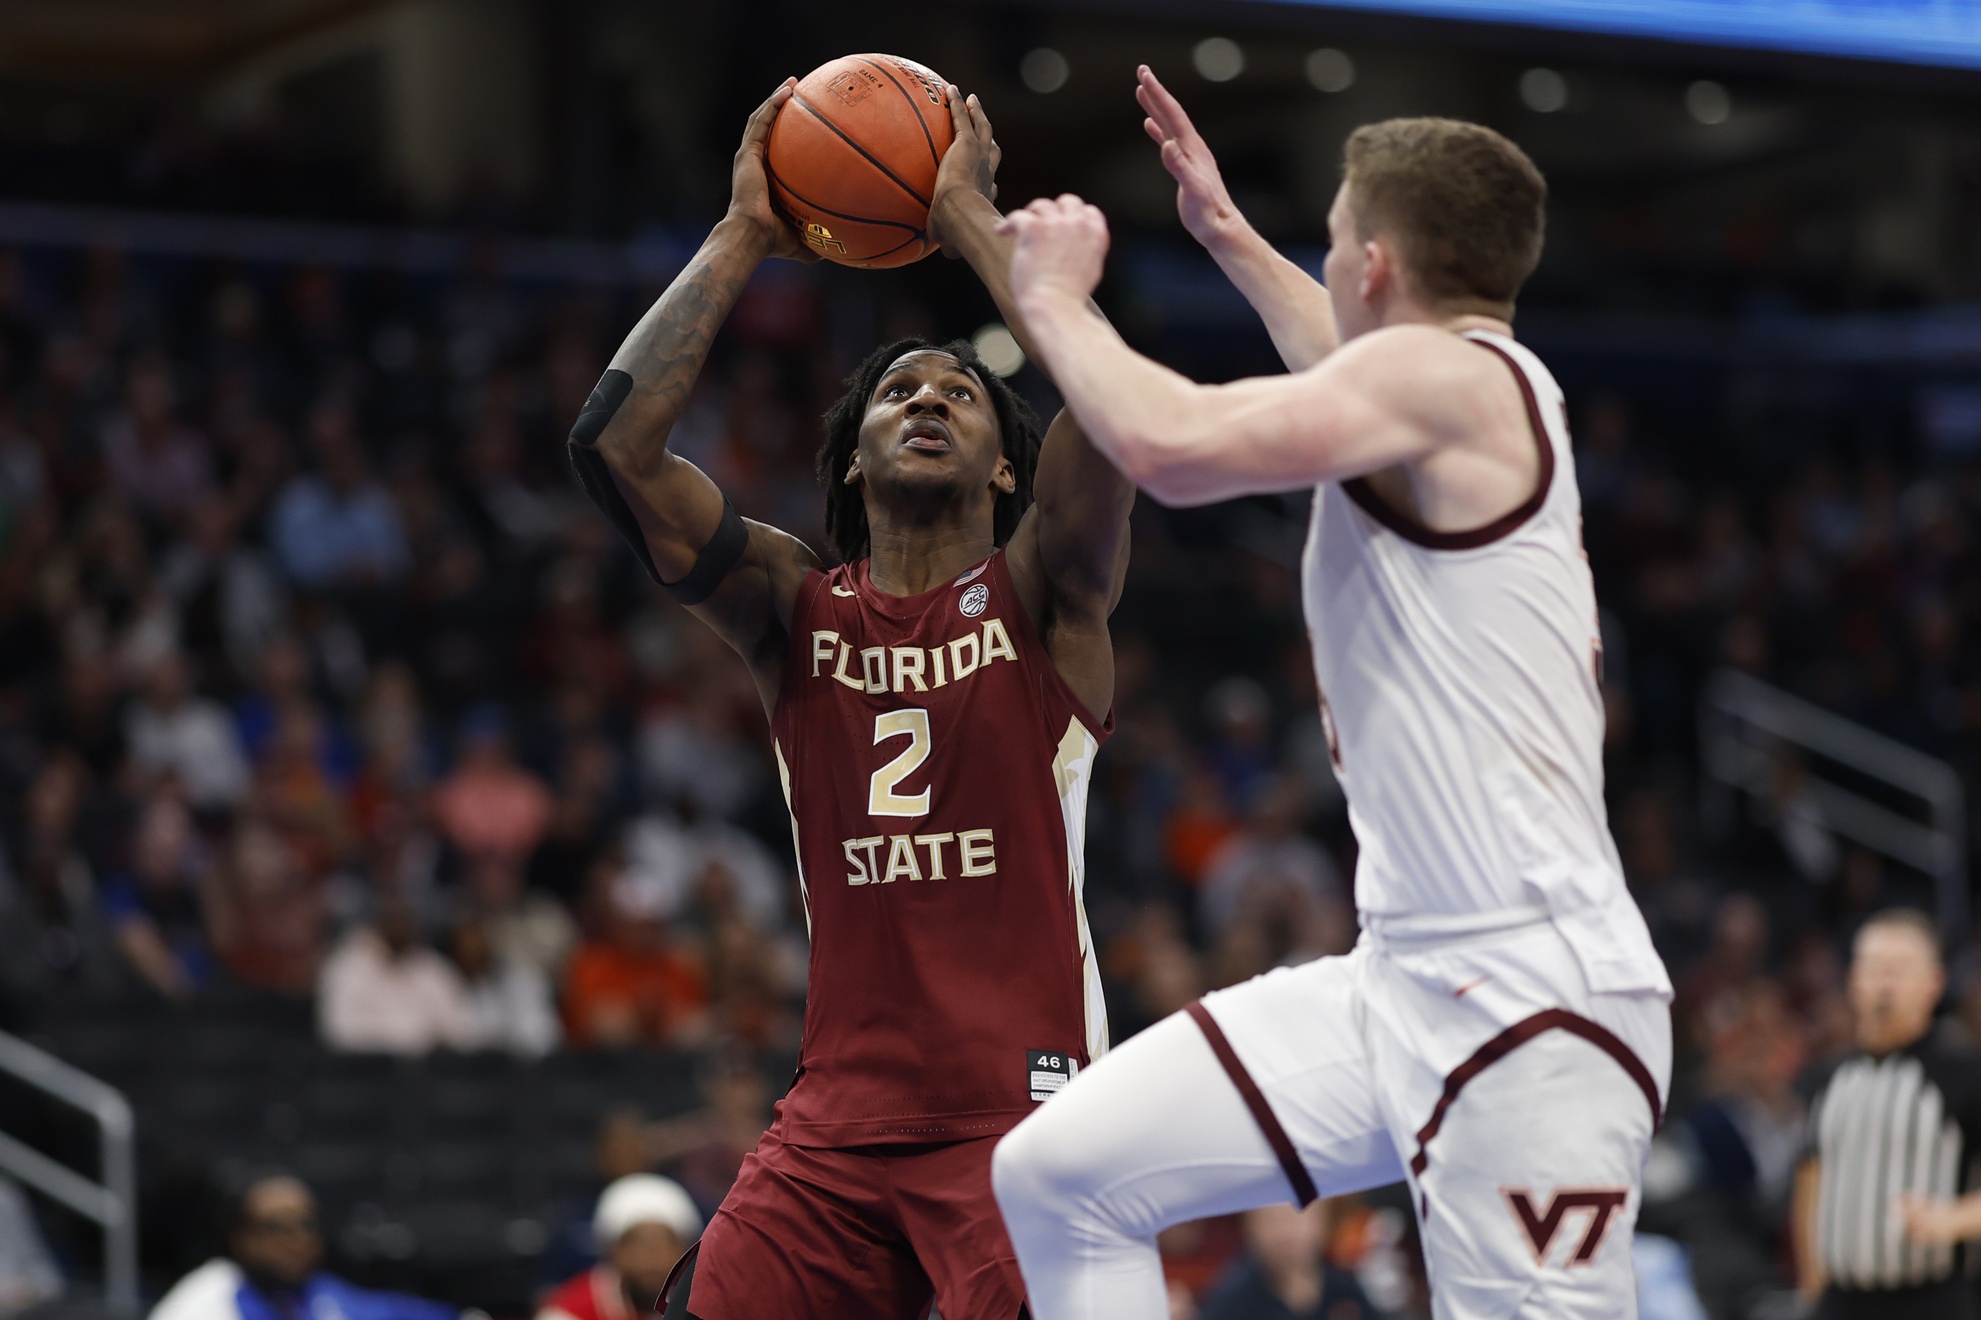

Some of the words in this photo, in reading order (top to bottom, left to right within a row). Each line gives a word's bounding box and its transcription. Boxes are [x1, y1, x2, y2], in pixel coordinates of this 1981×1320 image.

[811, 618, 1018, 694] FLORIDA
[868, 708, 932, 817] 2
[841, 828, 997, 886] STATE
[1037, 1055, 1061, 1069] 46
[1498, 1185, 1630, 1268] VT
